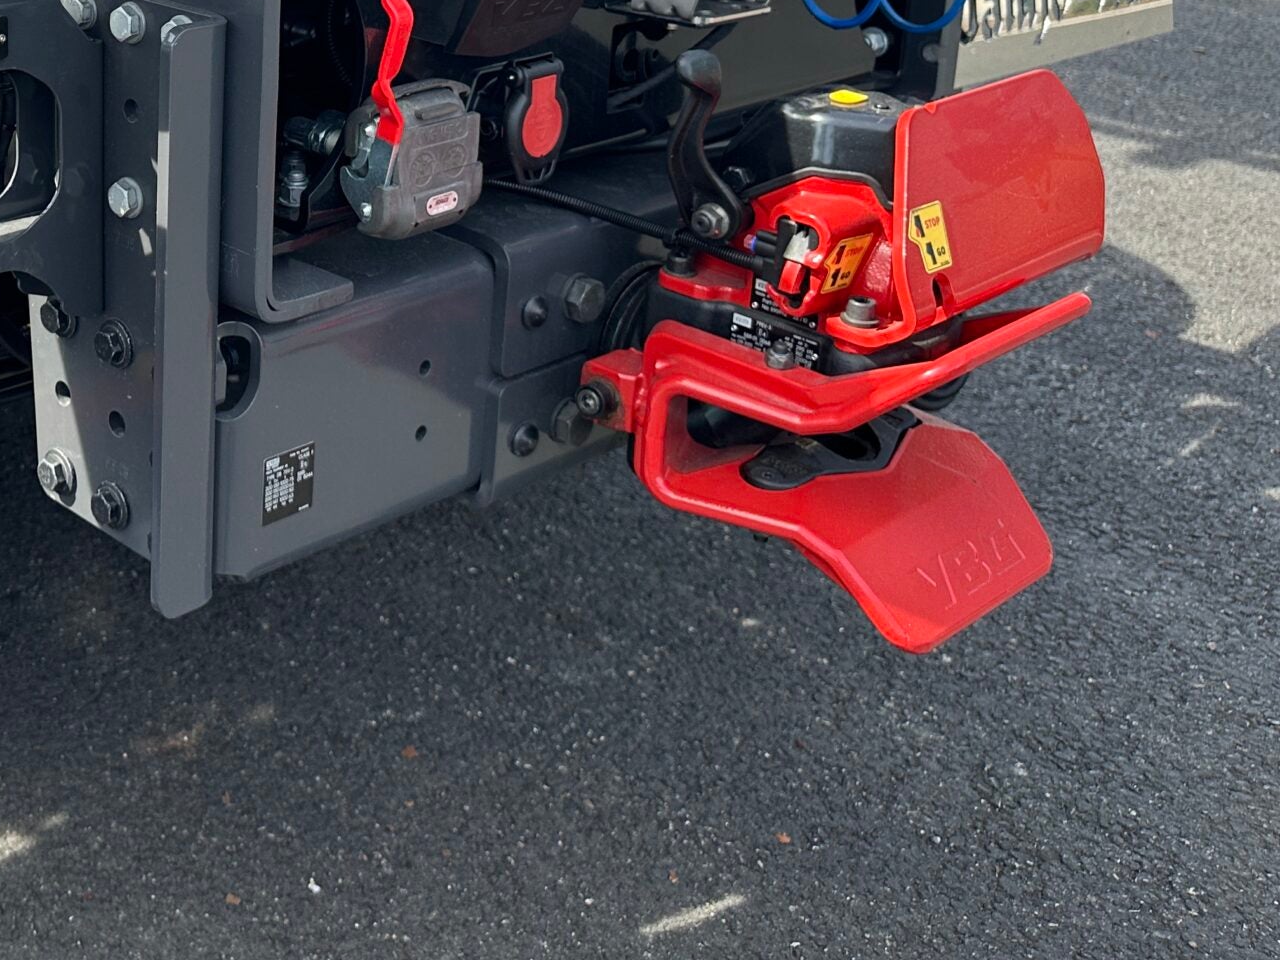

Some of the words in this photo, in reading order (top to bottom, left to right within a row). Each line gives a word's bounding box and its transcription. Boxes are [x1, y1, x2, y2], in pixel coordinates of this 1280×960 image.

[924, 216, 940, 229] STOP
[845, 246, 864, 257] STOP
[936, 246, 946, 257] GO
[840, 271, 851, 280] GO
